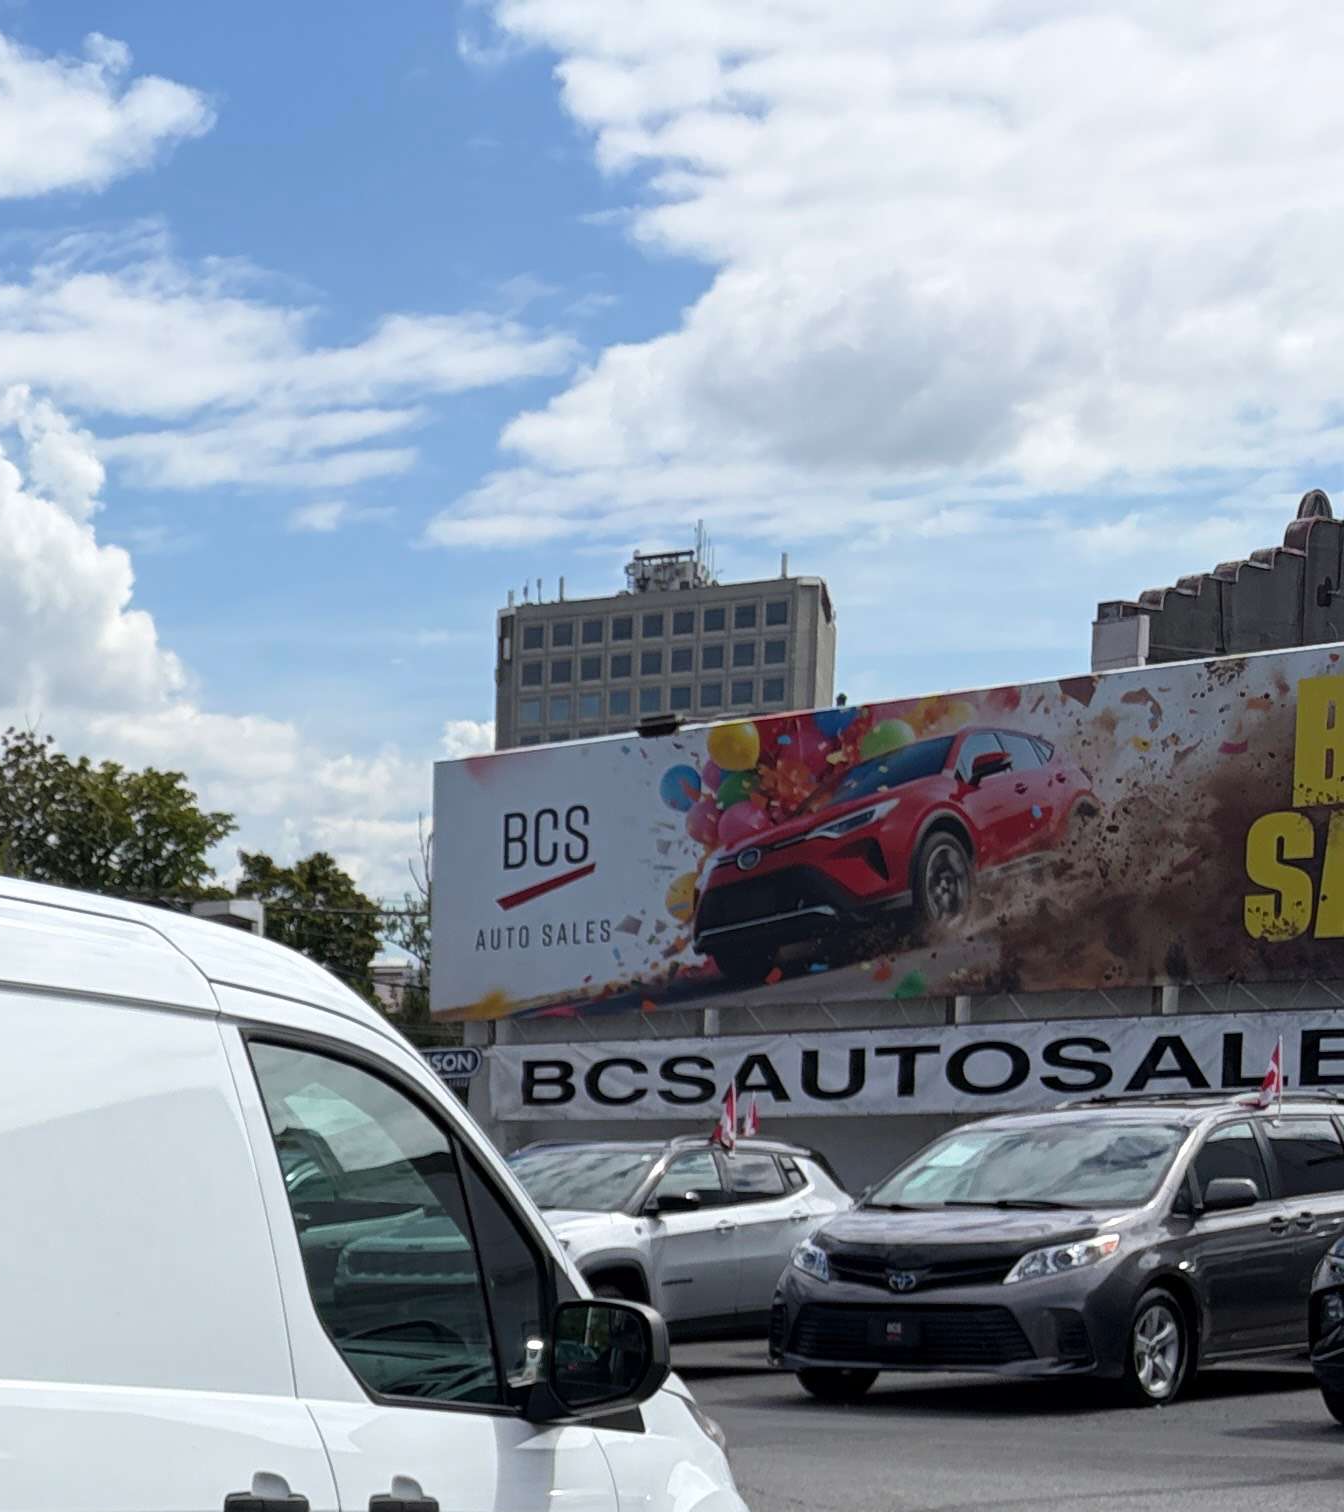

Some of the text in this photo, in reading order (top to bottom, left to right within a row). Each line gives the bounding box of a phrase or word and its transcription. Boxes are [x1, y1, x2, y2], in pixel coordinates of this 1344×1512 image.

[503, 804, 590, 871] BCS
[475, 919, 611, 951] AUTO SALES
